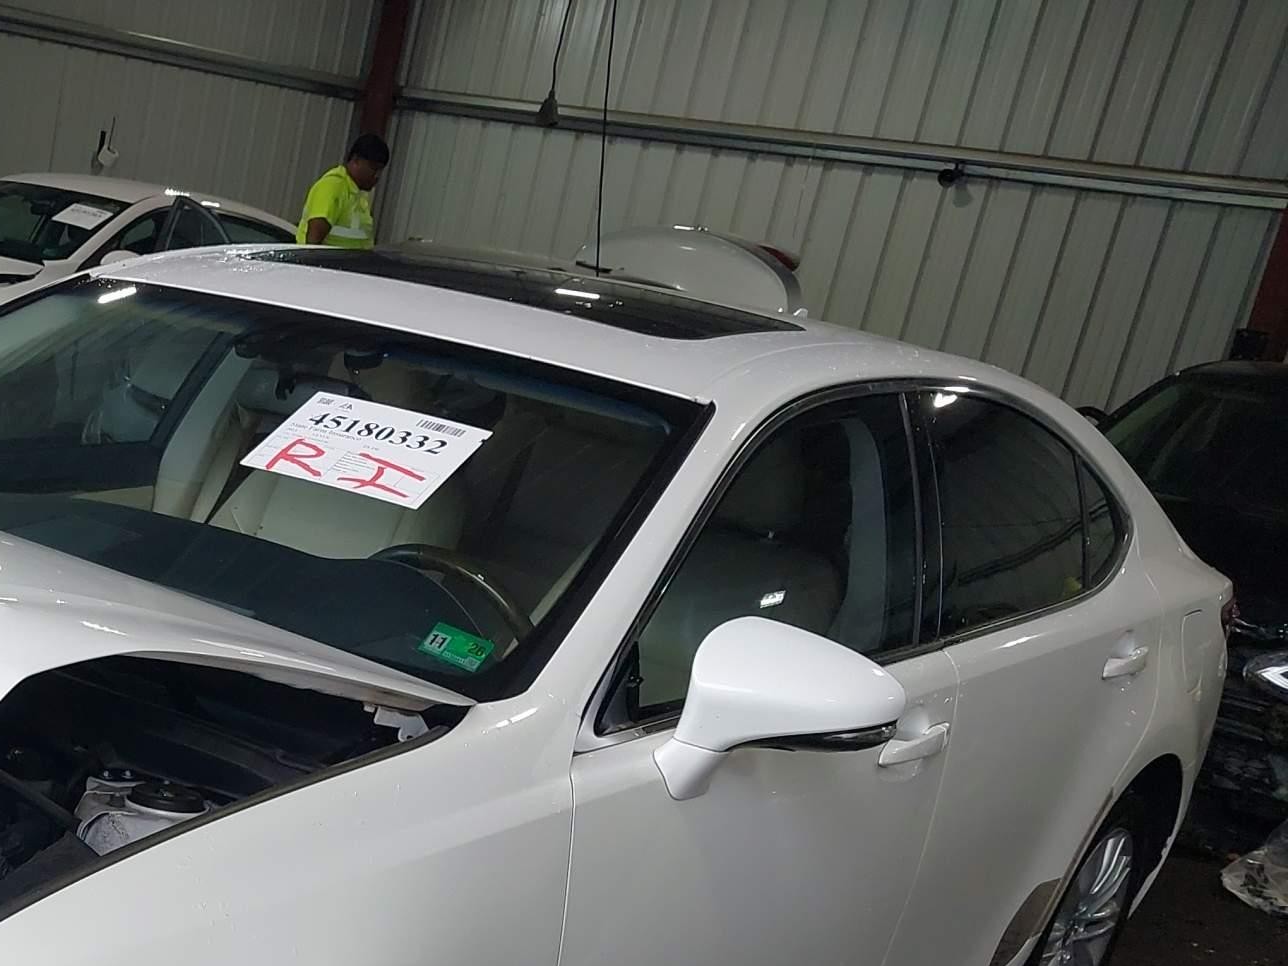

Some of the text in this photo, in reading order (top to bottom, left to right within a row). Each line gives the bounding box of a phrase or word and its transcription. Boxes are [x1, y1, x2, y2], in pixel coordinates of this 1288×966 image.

[309, 412, 448, 455] 45180332
[265, 438, 326, 477] R
[429, 633, 448, 649] 11
[467, 642, 487, 657] 26
